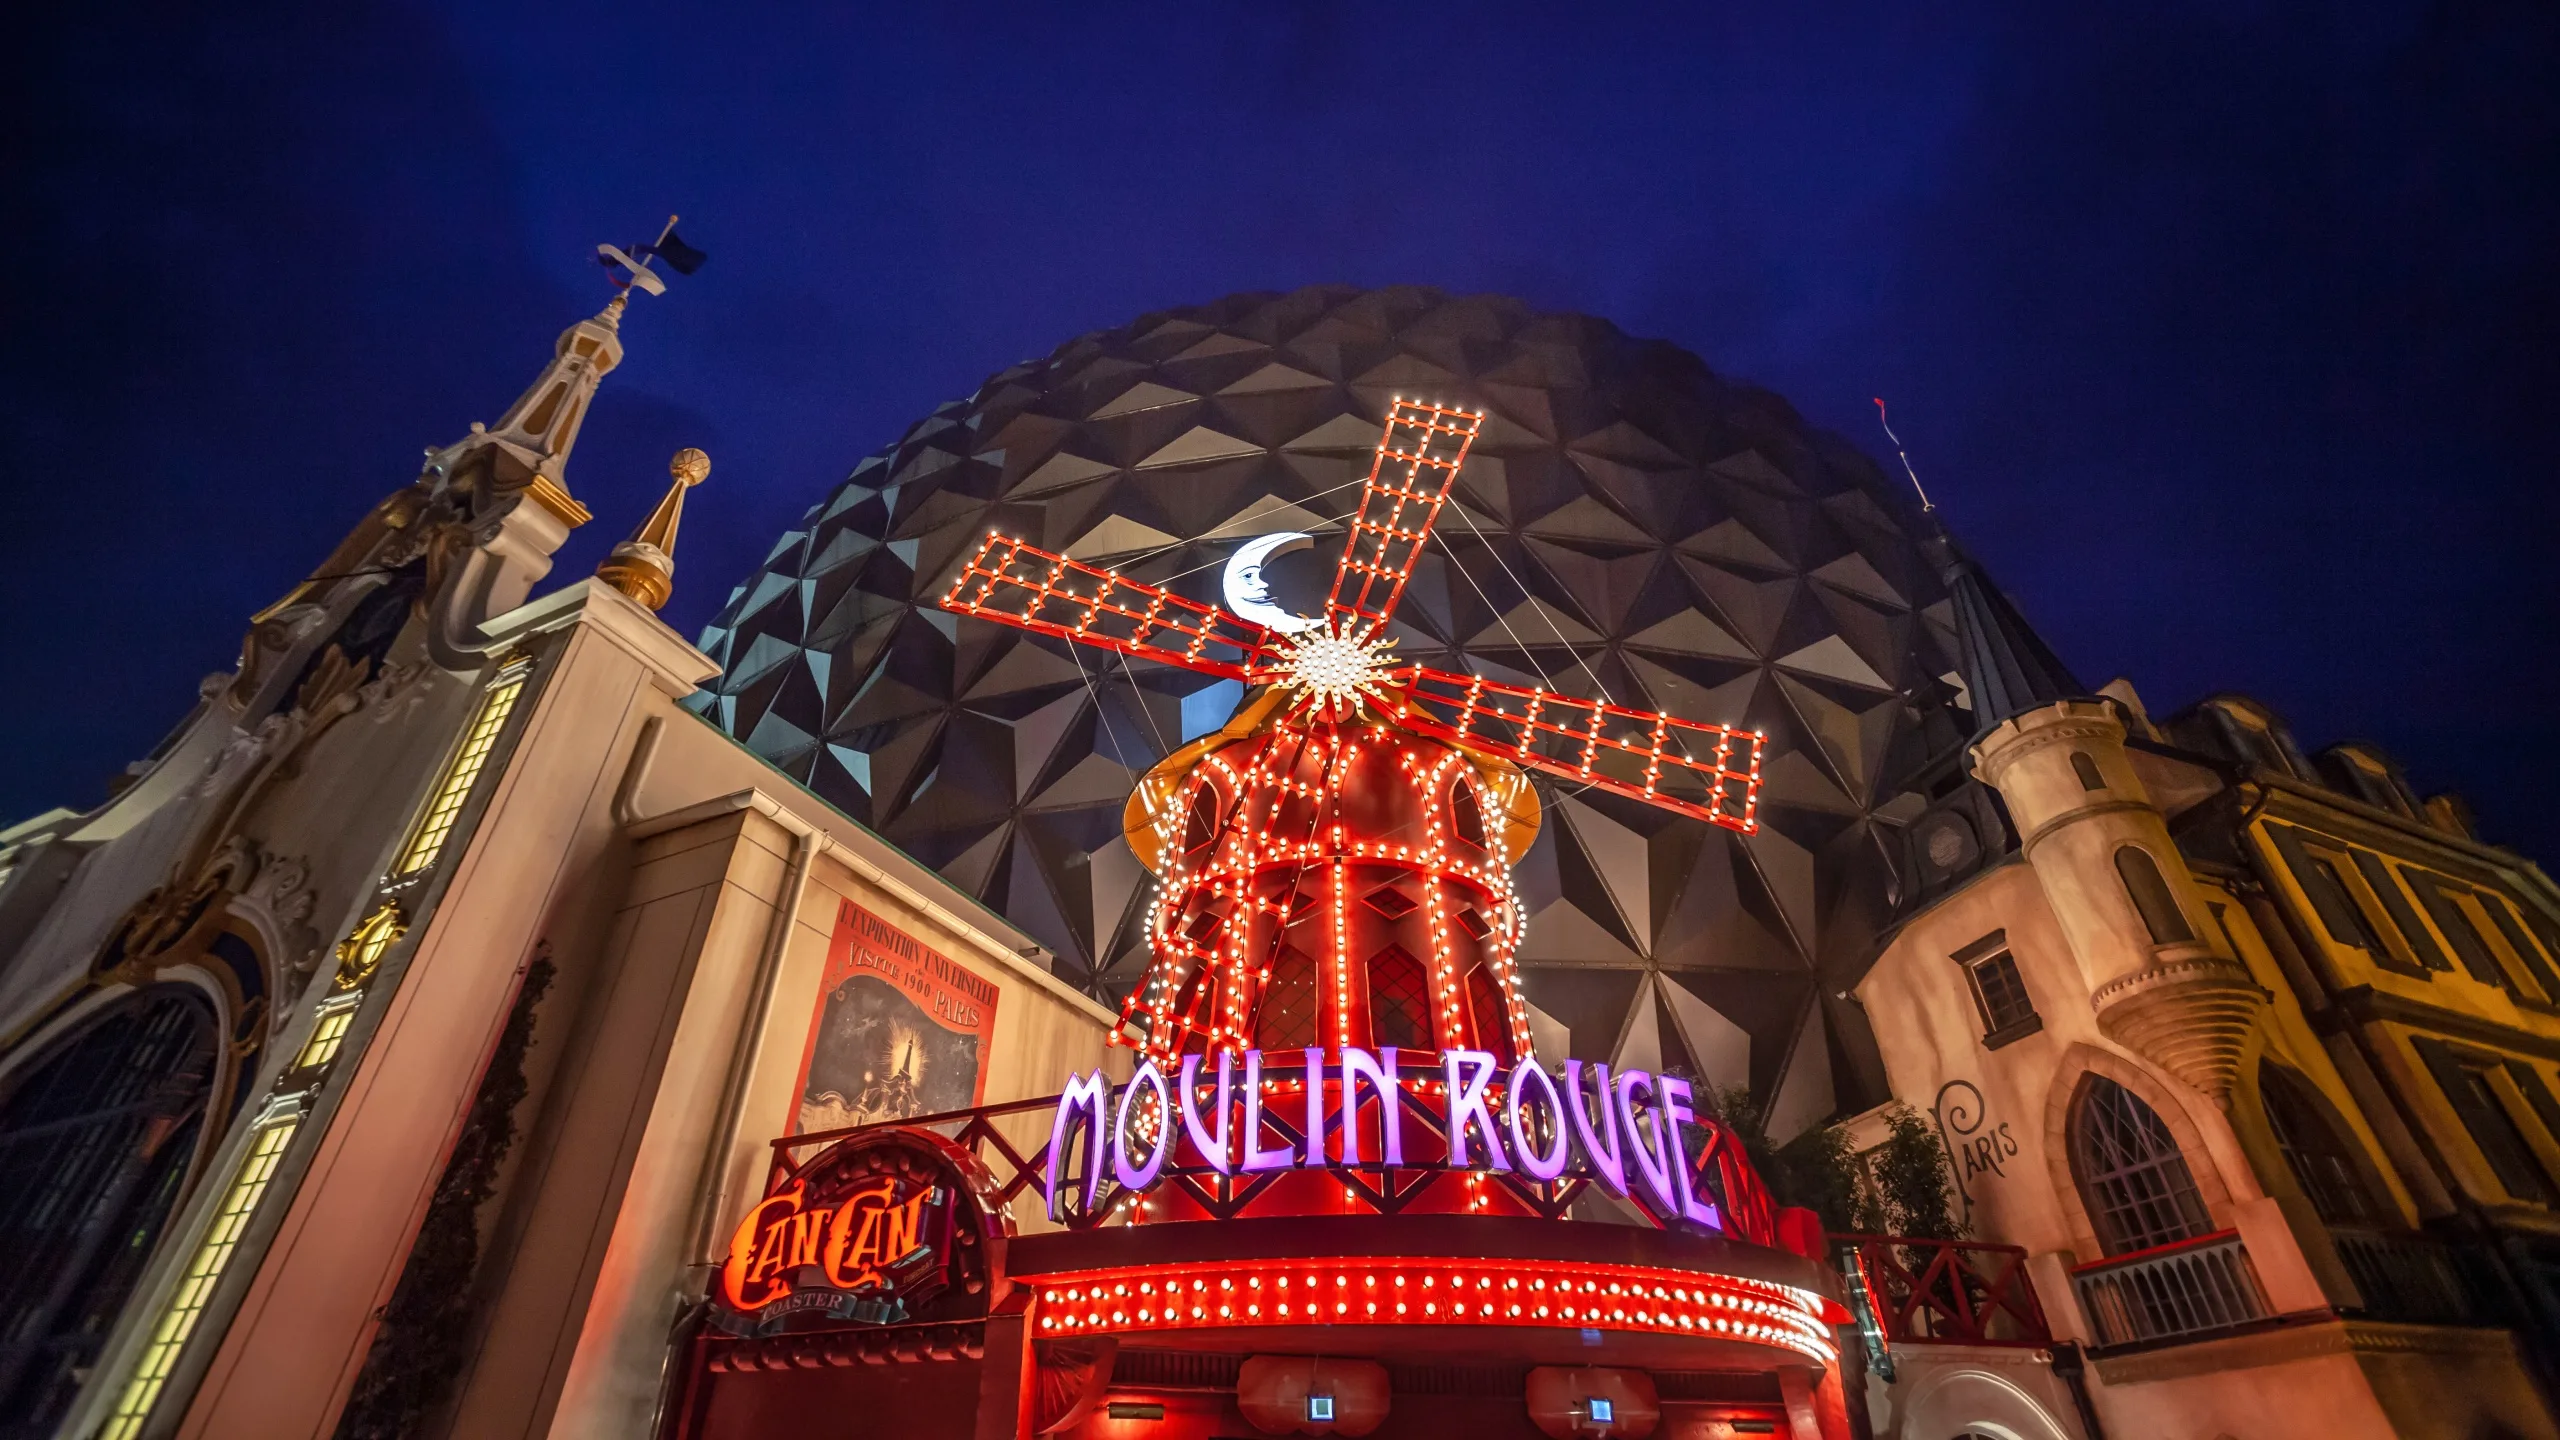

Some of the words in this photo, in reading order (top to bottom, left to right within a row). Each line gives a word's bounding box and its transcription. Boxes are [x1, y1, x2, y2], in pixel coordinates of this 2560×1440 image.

[840, 902, 921, 965] L'EXPOSITION
[924, 950, 994, 1007] UNIVERSELLE
[848, 941, 900, 981] VISITE
[903, 972, 932, 998] 1900
[932, 990, 980, 1028] PARIS
[1046, 1046, 1405, 1225] MOULIN
[1440, 1050, 1722, 1231] ROUGE
[1928, 1079, 2019, 1230] PARIS
